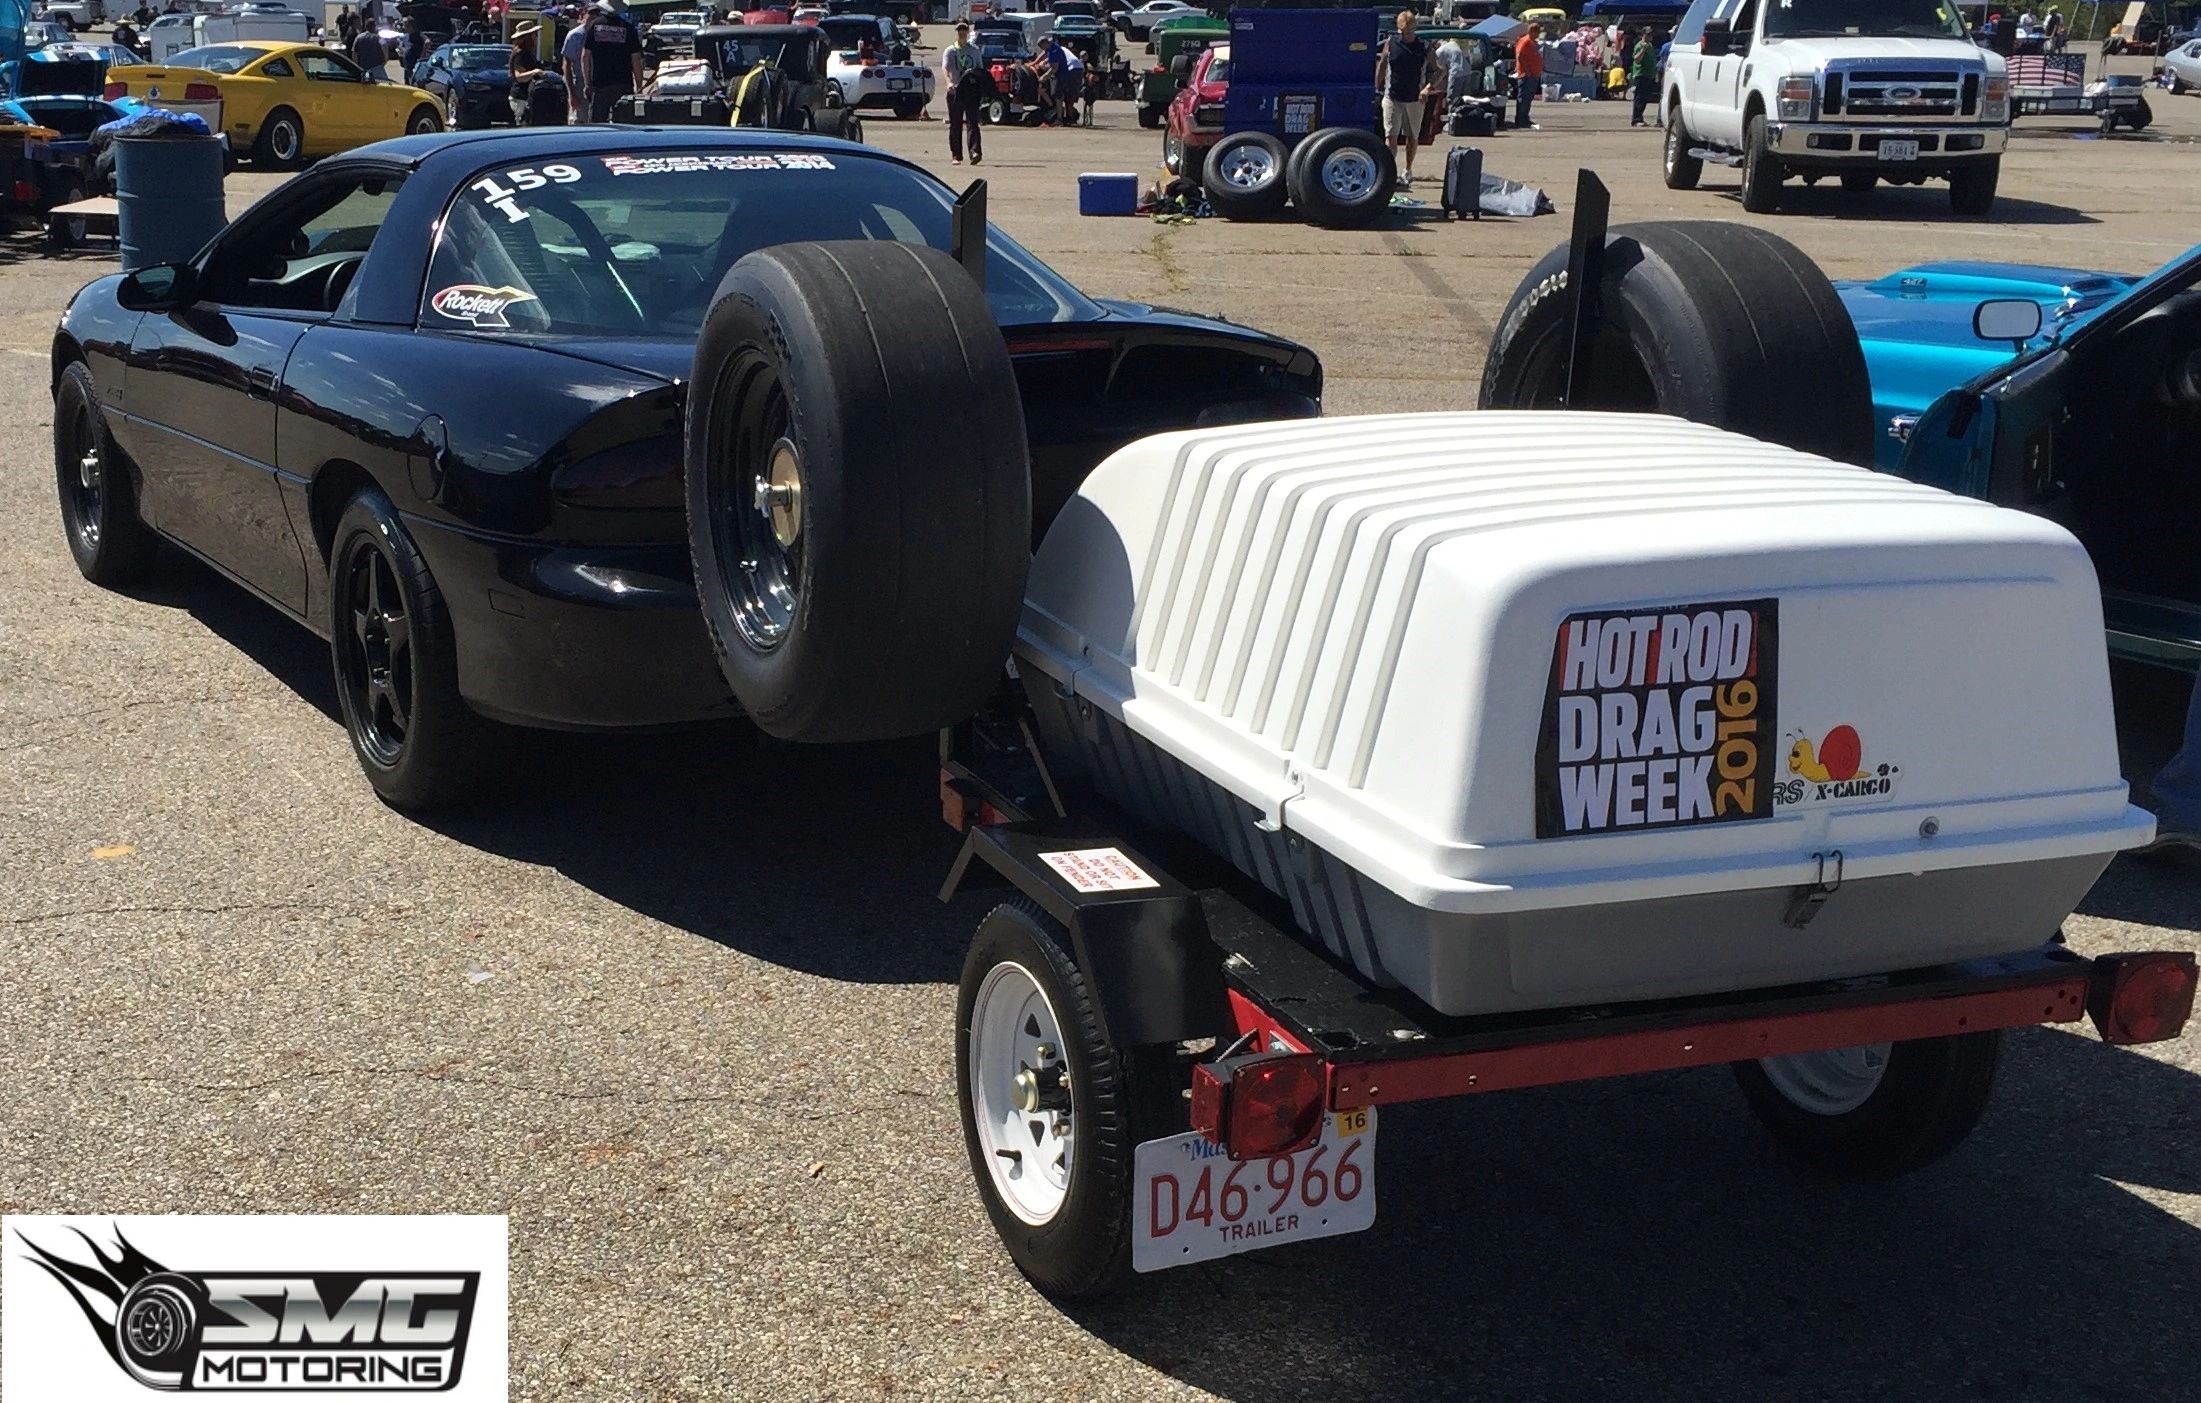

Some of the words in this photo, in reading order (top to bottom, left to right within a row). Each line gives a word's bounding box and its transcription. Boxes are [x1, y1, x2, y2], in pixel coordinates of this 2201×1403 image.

[723, 40, 739, 51] 45
[726, 51, 736, 63] A
[1285, 114, 1309, 123] DRAG
[613, 164, 709, 176] POWER
[711, 161, 782, 171] TOUR
[471, 164, 582, 204] 159
[1563, 617, 1657, 691] HOT
[1656, 609, 1752, 685] ROD
[1558, 686, 1717, 763] DRAG
[1716, 679, 1759, 817] 2016
[1558, 755, 1717, 831] WEEK
[1815, 778, 1891, 801] X-CARGO
[1344, 1112, 1366, 1131] 16
[1219, 1214, 1299, 1243] TRAILER
